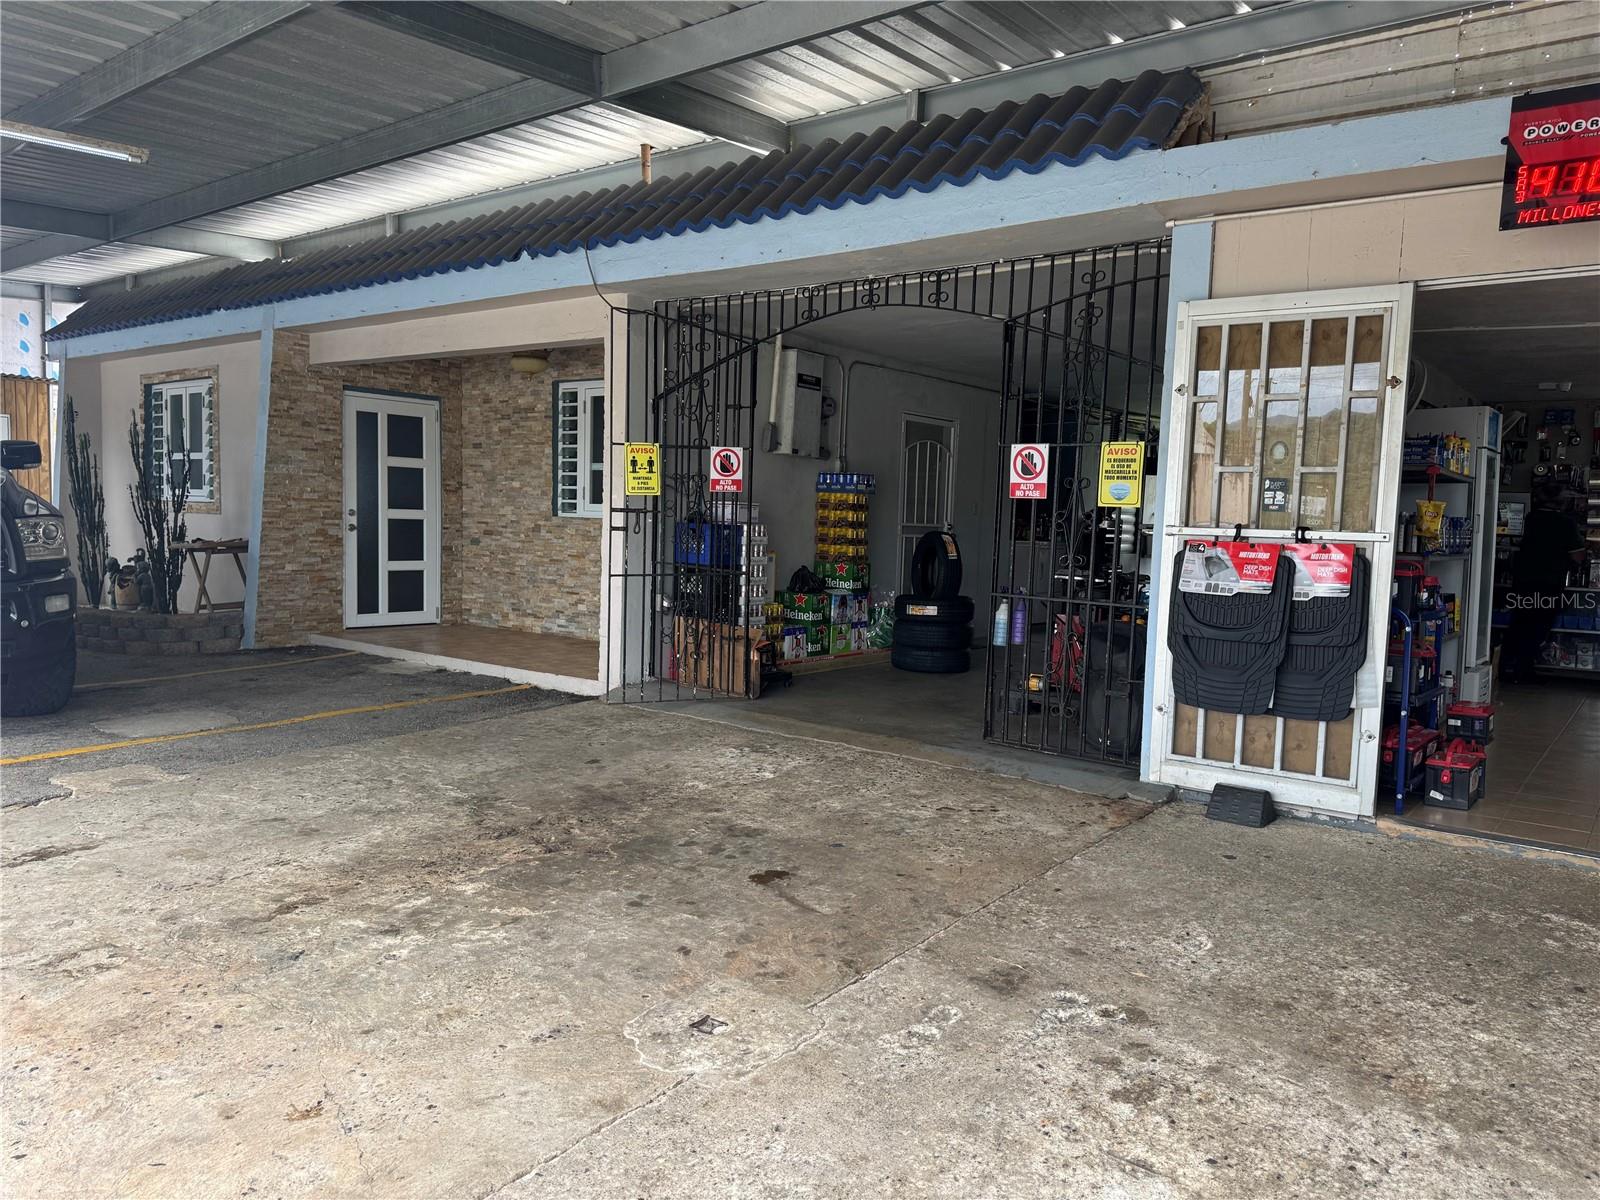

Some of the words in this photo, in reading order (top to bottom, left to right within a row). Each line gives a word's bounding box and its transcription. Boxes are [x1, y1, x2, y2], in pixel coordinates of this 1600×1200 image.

[1107, 447, 1137, 455] AVISO
[825, 577, 863, 589] Heineken
[784, 608, 824, 621] Heineken
